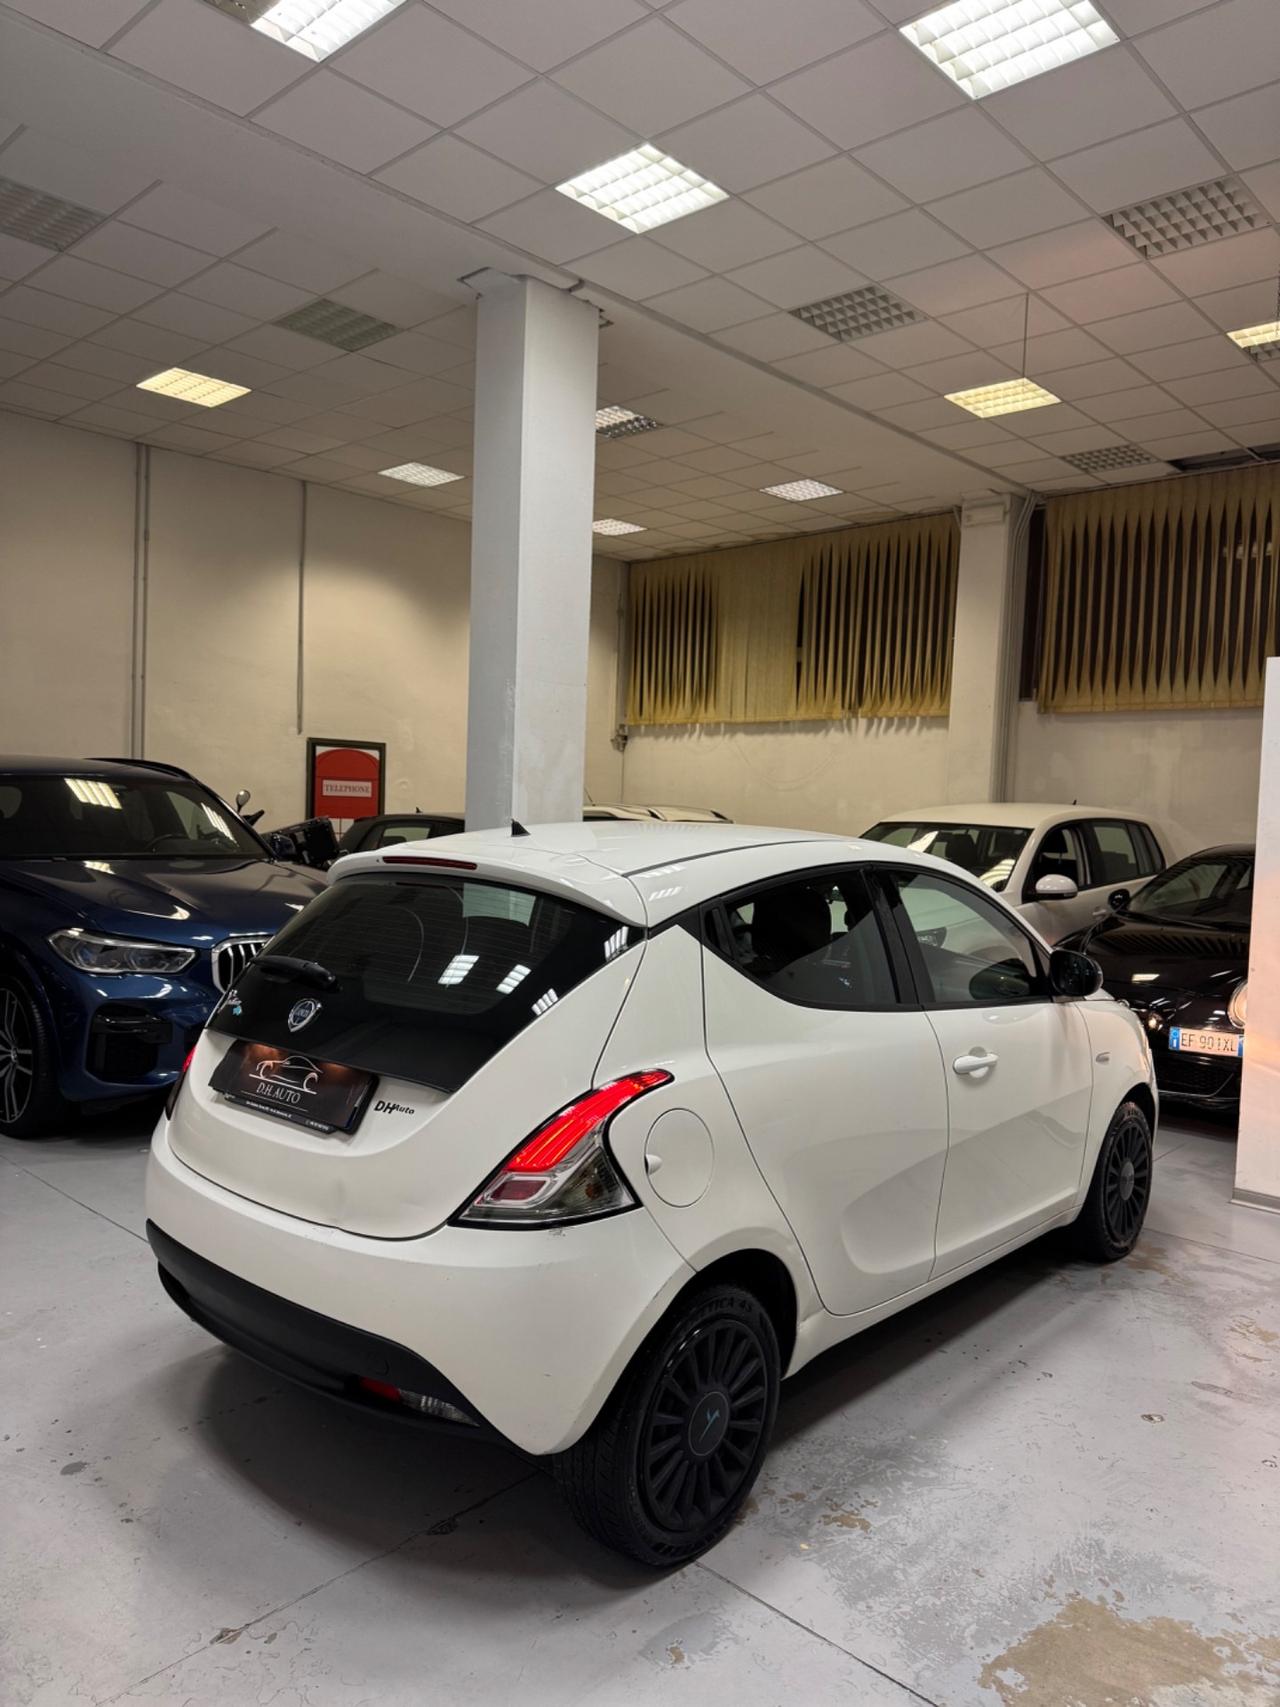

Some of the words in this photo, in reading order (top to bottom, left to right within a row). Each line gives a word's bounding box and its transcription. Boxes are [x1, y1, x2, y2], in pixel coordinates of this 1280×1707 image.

[325, 783, 370, 794] TELEPHONE
[1181, 1032, 1195, 1048] EF
[273, 1087, 301, 1104] AUTO
